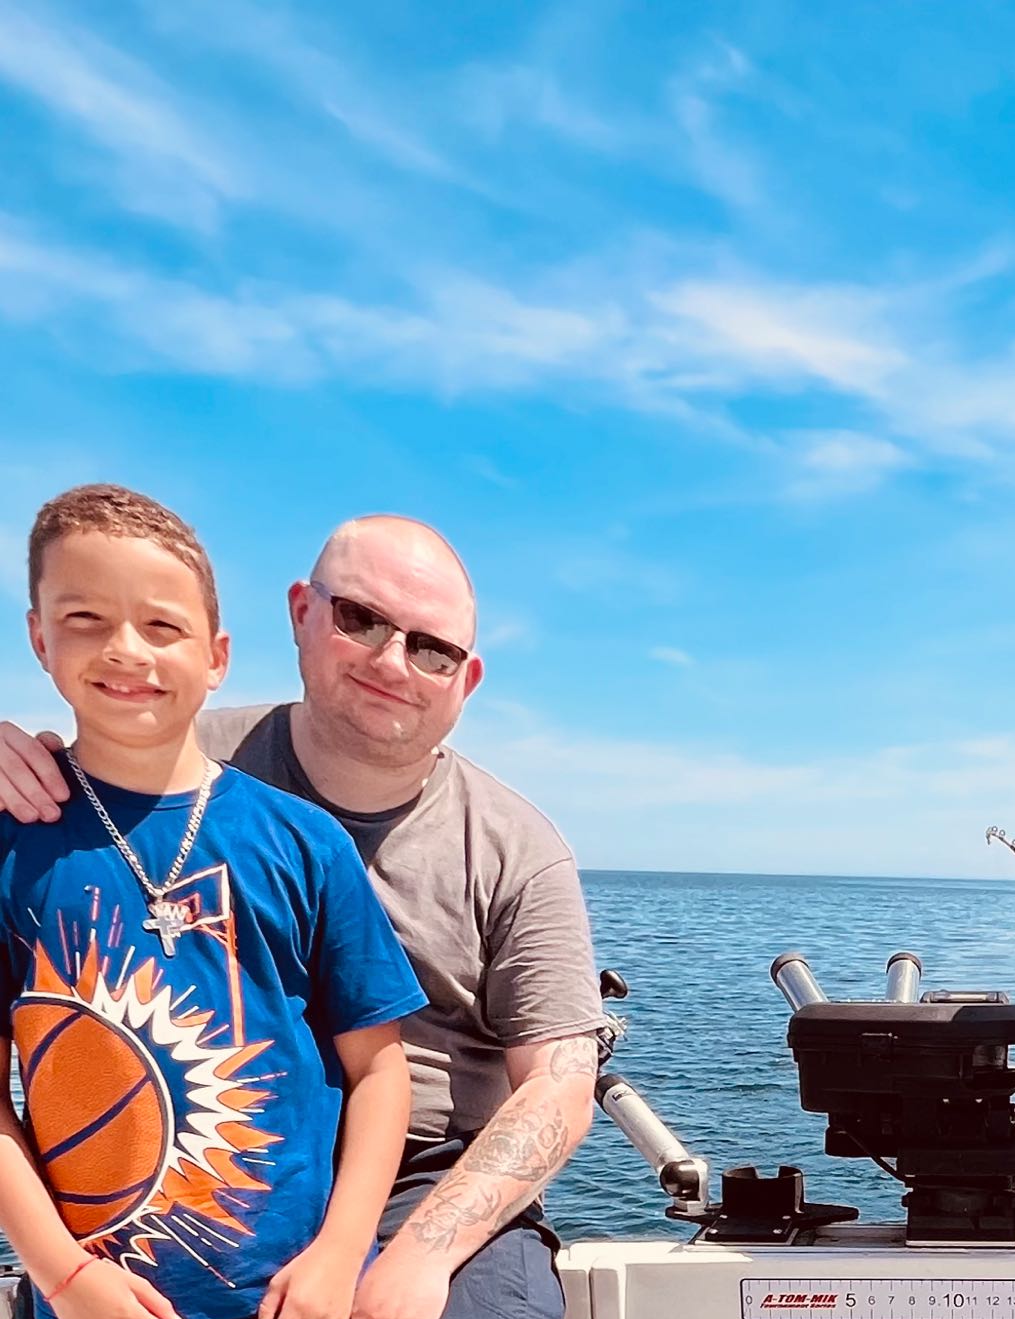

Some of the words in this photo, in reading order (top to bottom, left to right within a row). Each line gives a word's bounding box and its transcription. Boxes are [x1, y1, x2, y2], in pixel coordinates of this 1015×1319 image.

[762, 1294, 838, 1303] A-TOM-MIK
[845, 1293, 856, 1307] 5
[868, 1296, 876, 1305] 6
[888, 1296, 895, 1305] 7
[908, 1296, 916, 1305] 8
[928, 1296, 936, 1305] 9
[943, 1293, 965, 1307] 10
[966, 1296, 978, 1305] 11
[987, 1296, 1000, 1306] 12
